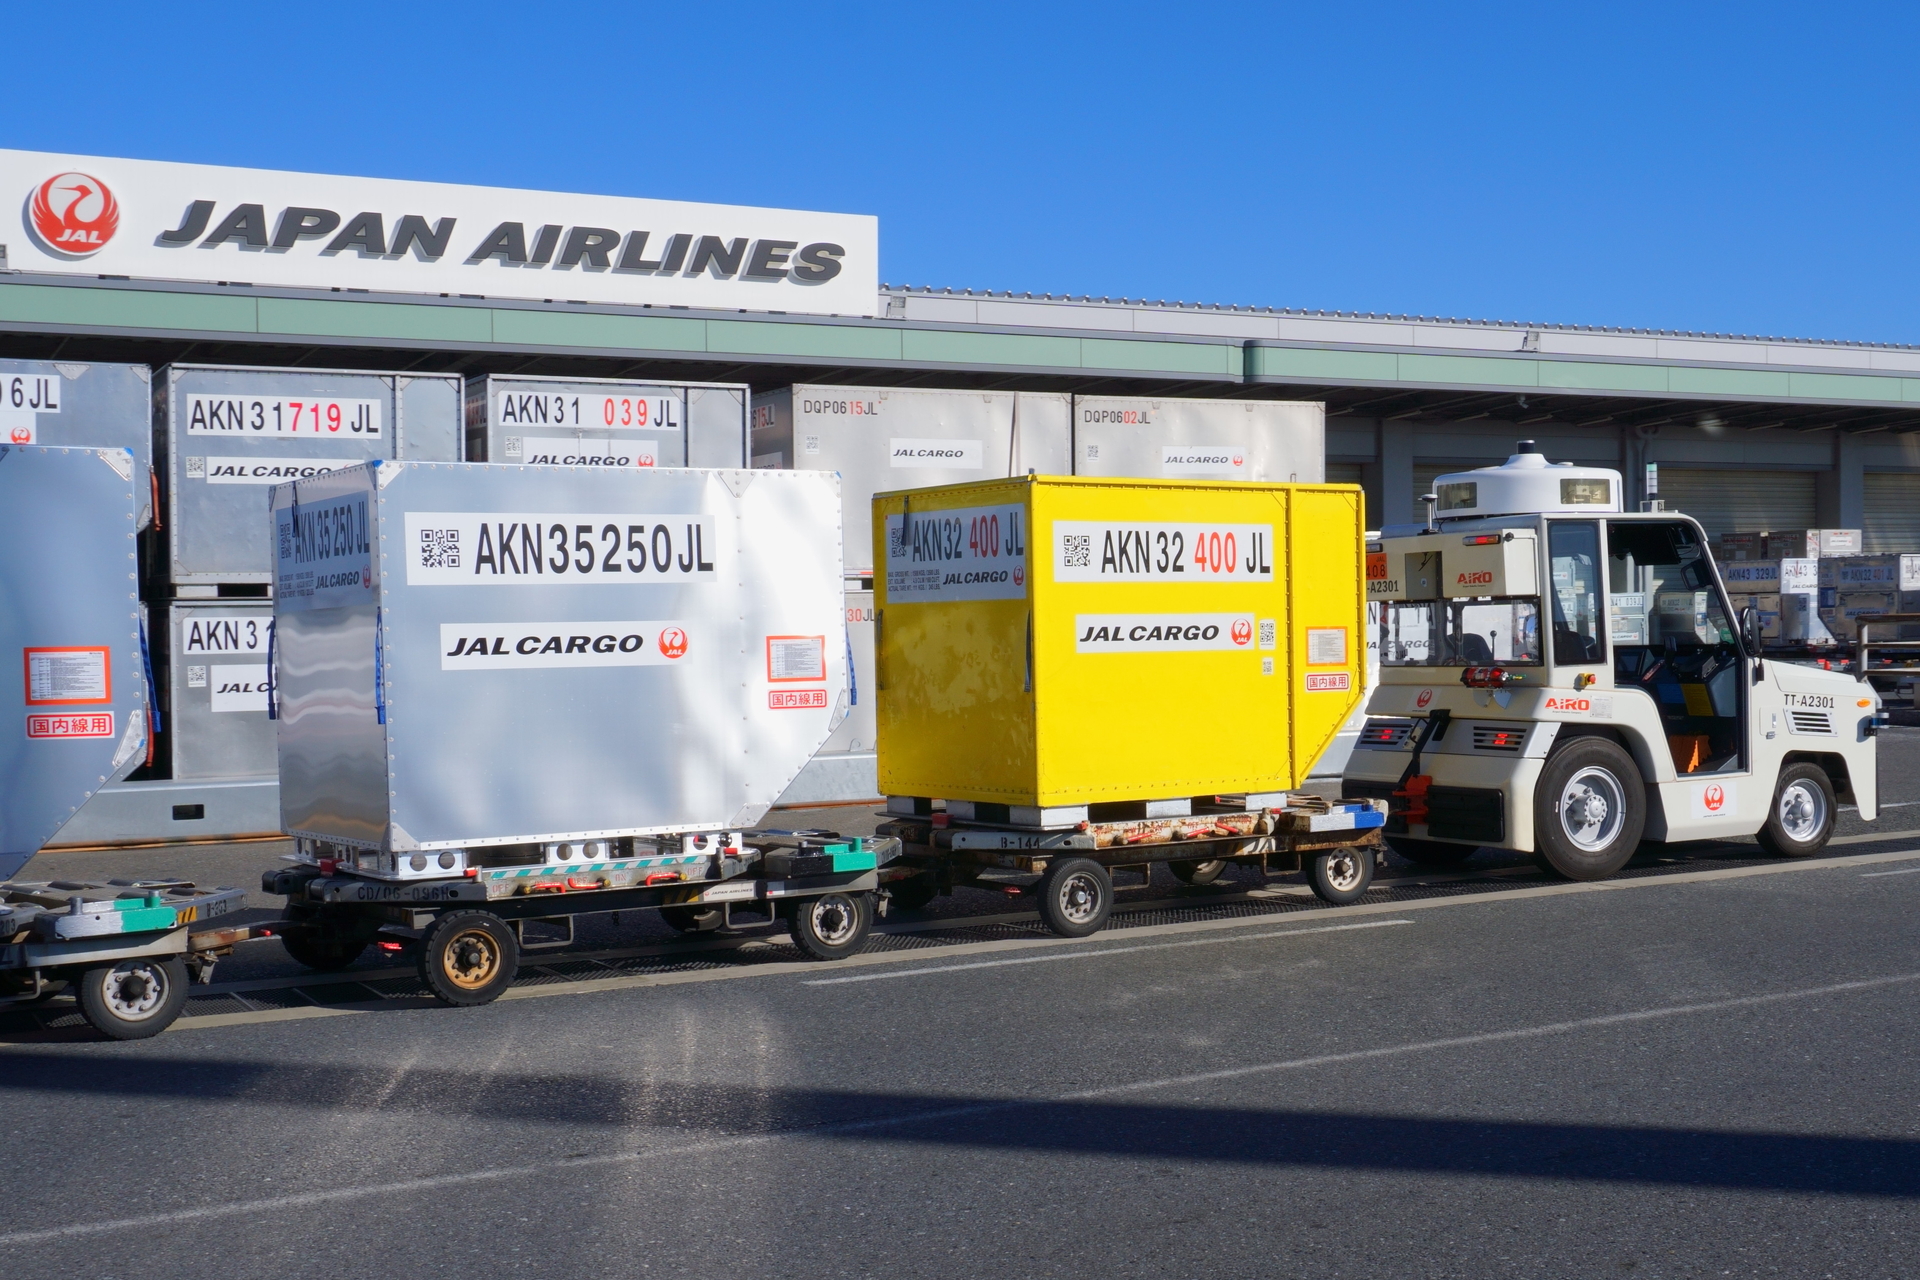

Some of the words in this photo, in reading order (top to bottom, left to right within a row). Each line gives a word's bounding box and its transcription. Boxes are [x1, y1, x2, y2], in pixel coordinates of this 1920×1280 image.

[56, 228, 103, 244] JAL
[161, 199, 457, 258] JAPAN
[471, 221, 846, 281] AIRLINES
[1084, 409, 1151, 425] DQP0602JL
[1309, 676, 1347, 688] 国内線用
[772, 692, 824, 706] 国内線用
[1784, 693, 1835, 709] TT-A2301
[33, 717, 107, 734] 国内線用
